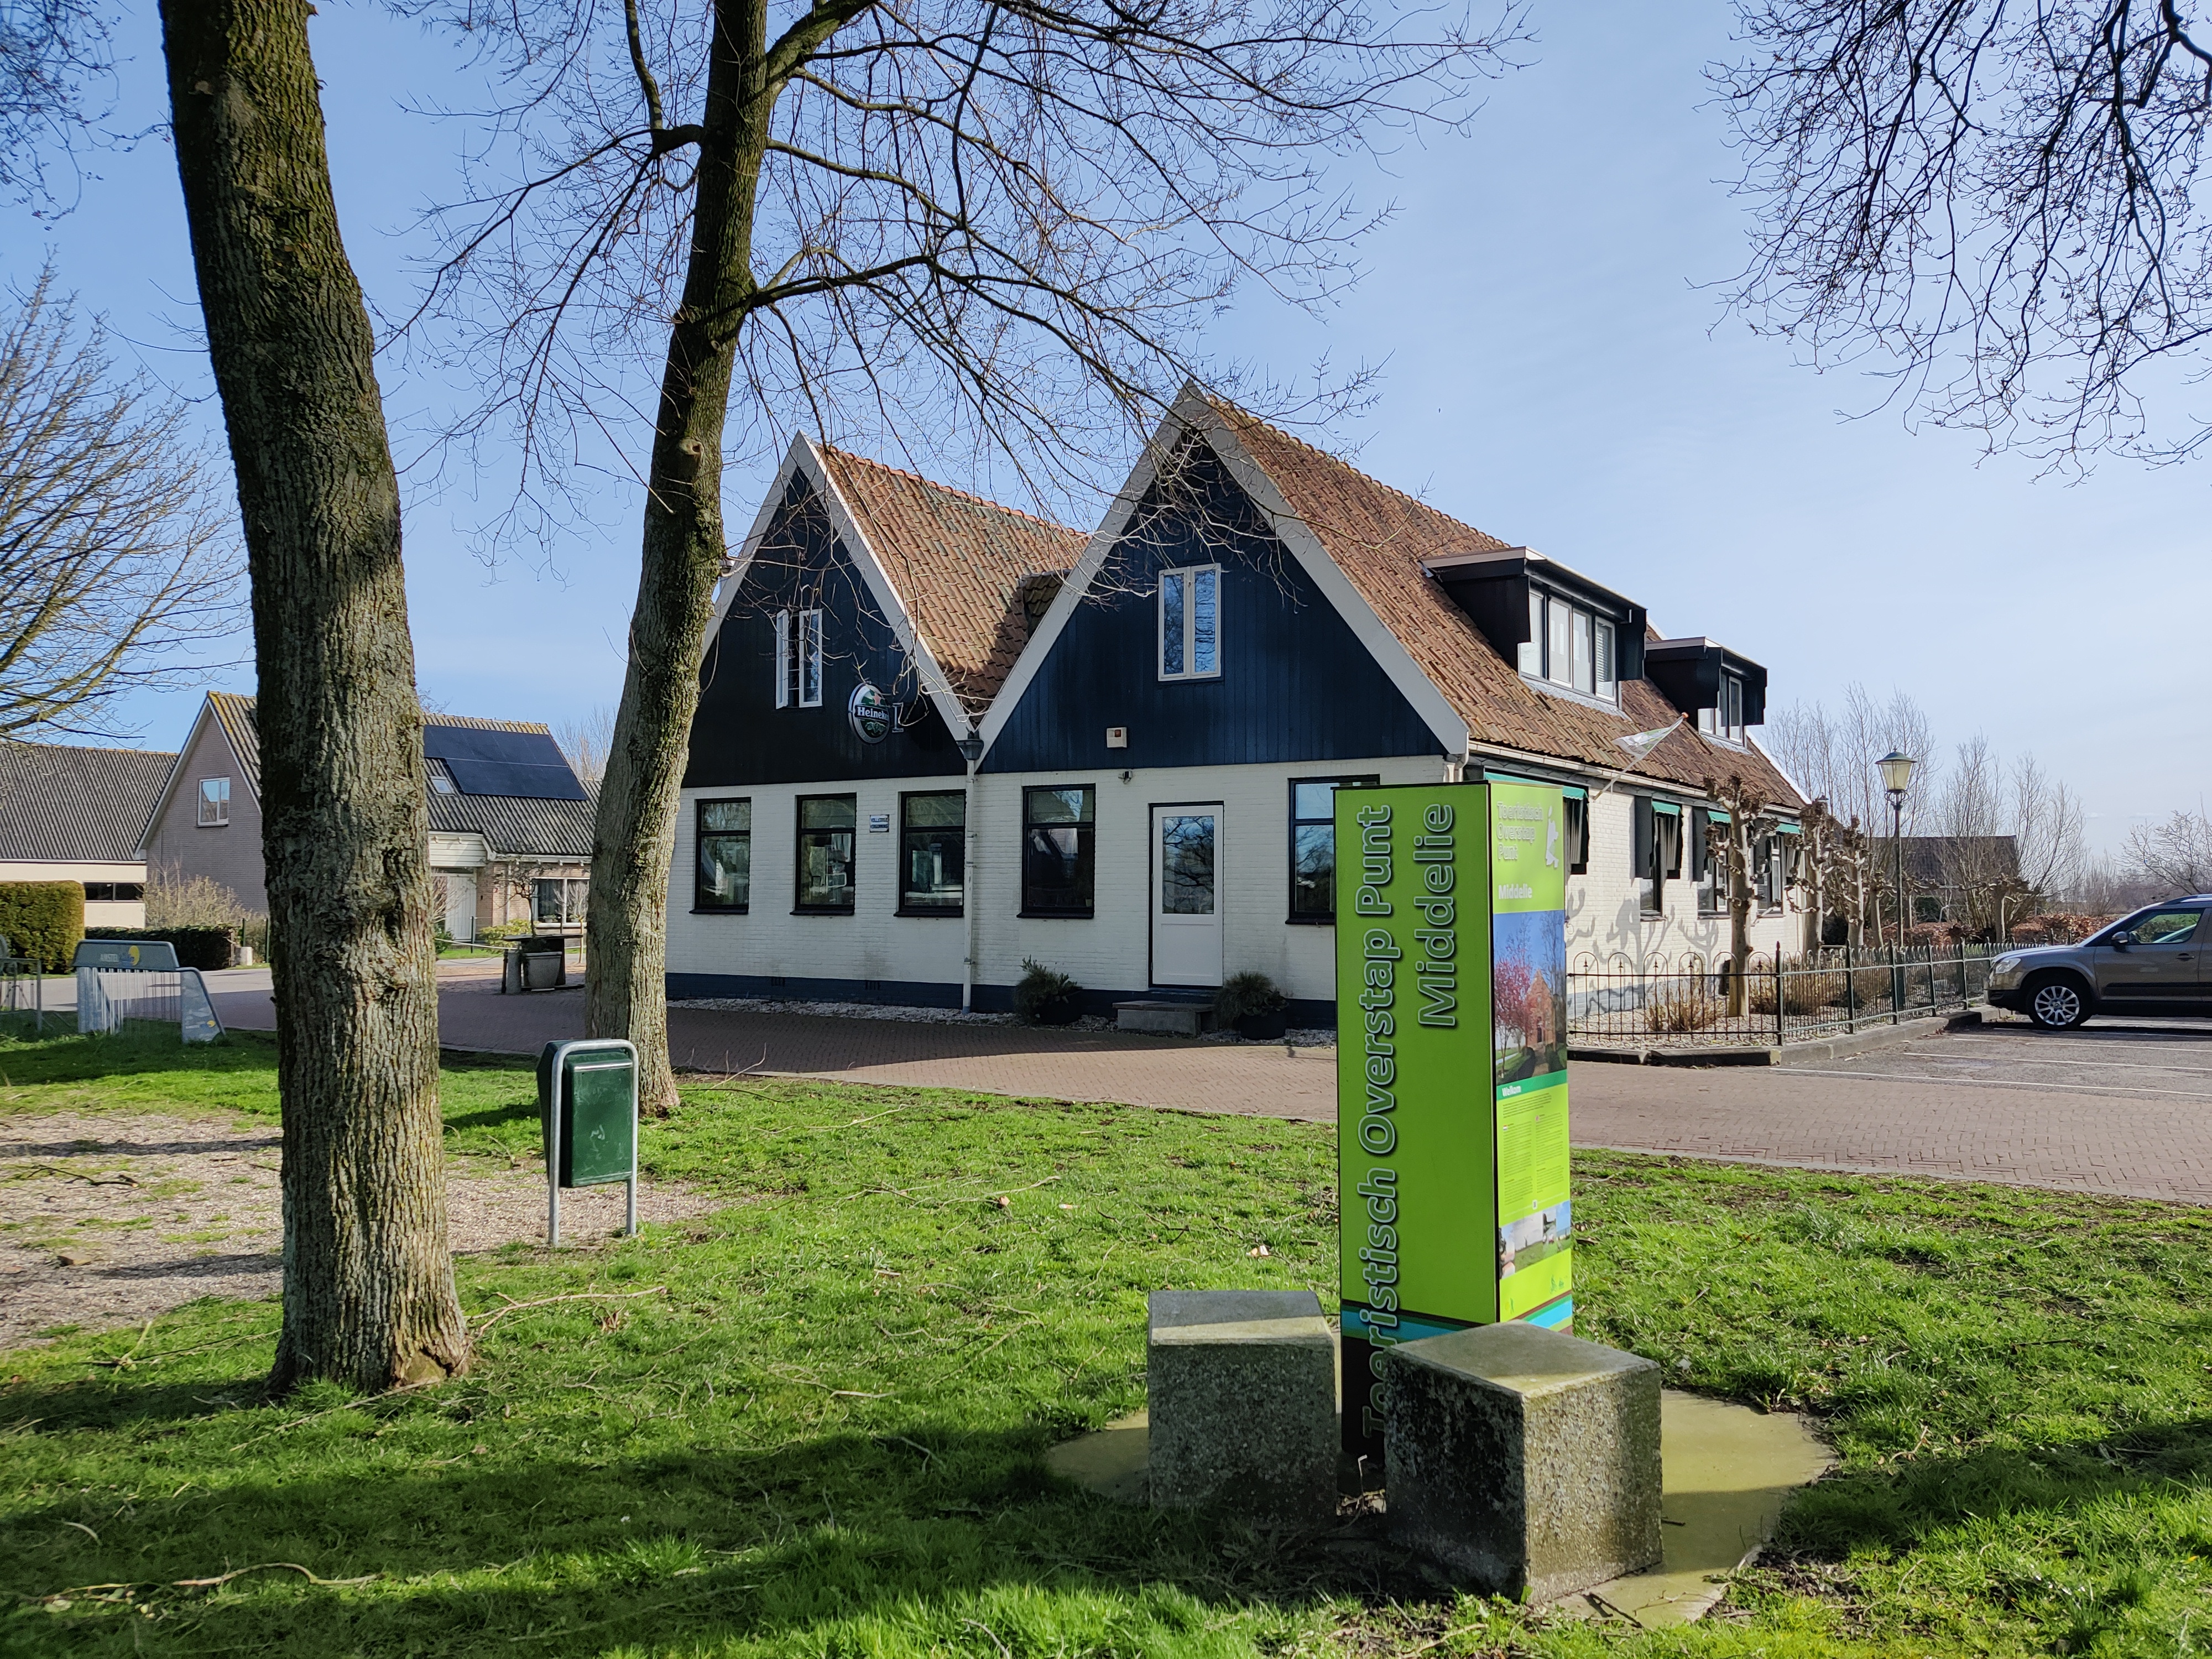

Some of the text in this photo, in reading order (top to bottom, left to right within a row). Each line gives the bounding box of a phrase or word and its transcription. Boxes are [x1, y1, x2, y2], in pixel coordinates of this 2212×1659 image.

[1497, 801, 1543, 821] Toeristisch
[1497, 822, 1535, 843] Overstap
[1355, 804, 1391, 915] Punt
[1498, 843, 1518, 860] Punt
[1498, 883, 1532, 900] Middelie
[1413, 804, 1455, 1026] Middelie
[1358, 928, 1401, 1155] Overstap
[1502, 1086, 1521, 1097] Welkom
